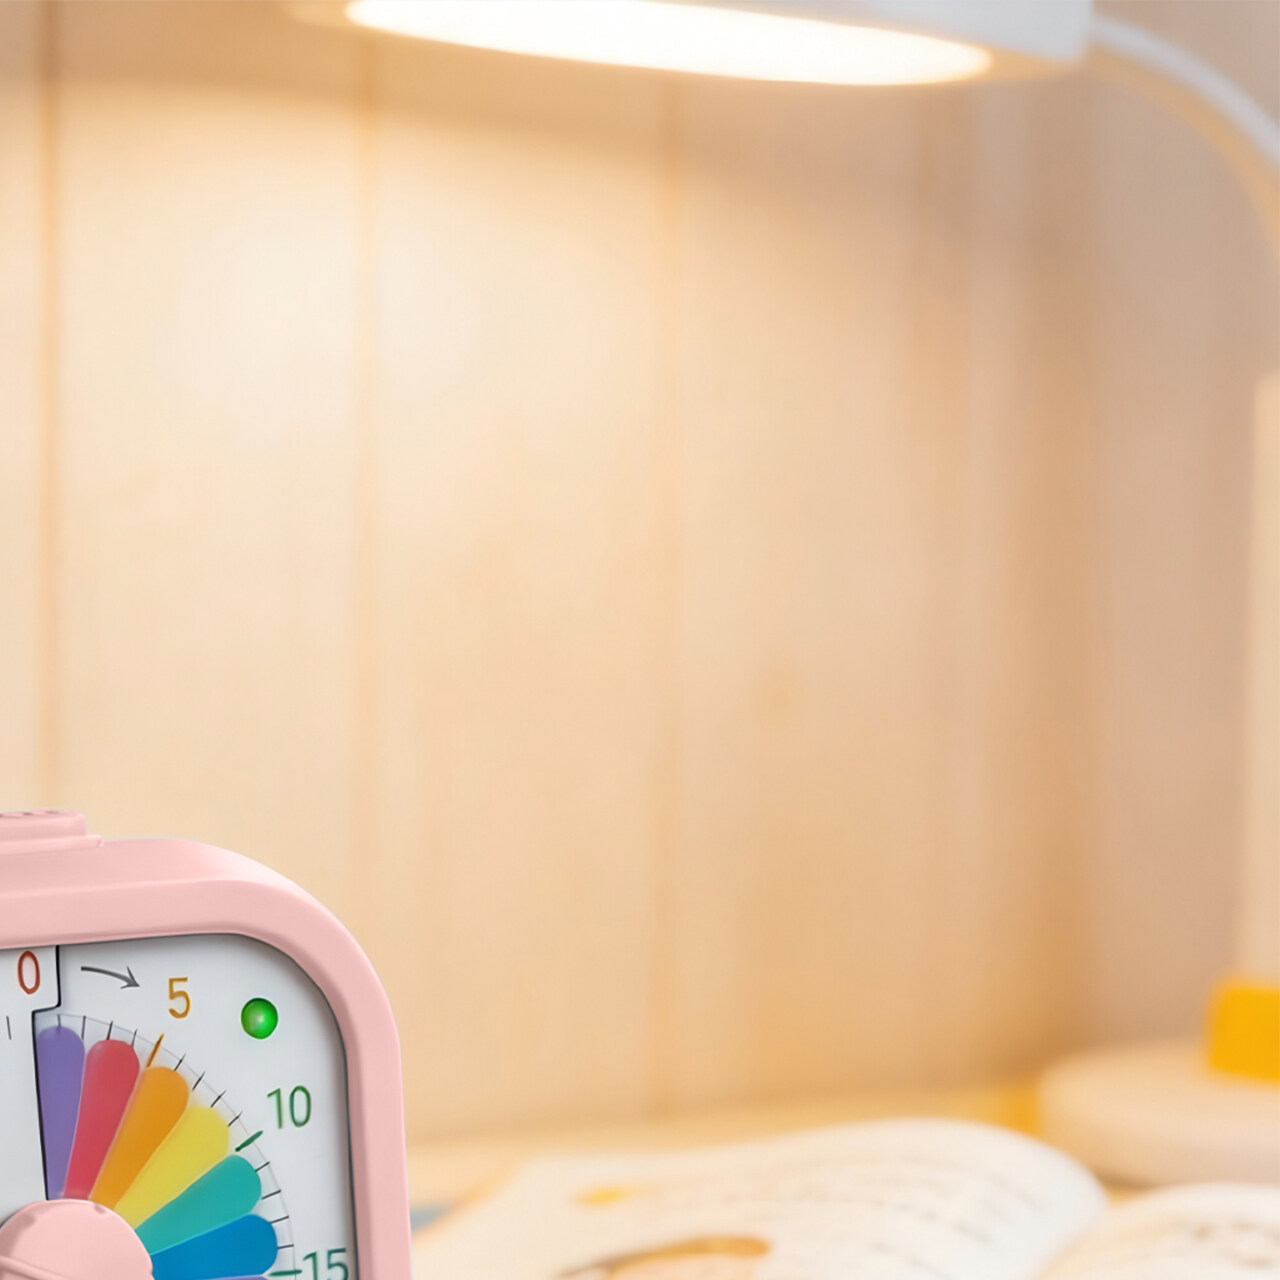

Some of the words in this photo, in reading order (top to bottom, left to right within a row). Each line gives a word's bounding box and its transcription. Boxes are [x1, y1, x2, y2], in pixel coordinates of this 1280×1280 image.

[17, 950, 41, 995] 0
[168, 977, 191, 1019] 5
[268, 1086, 311, 1128] 10
